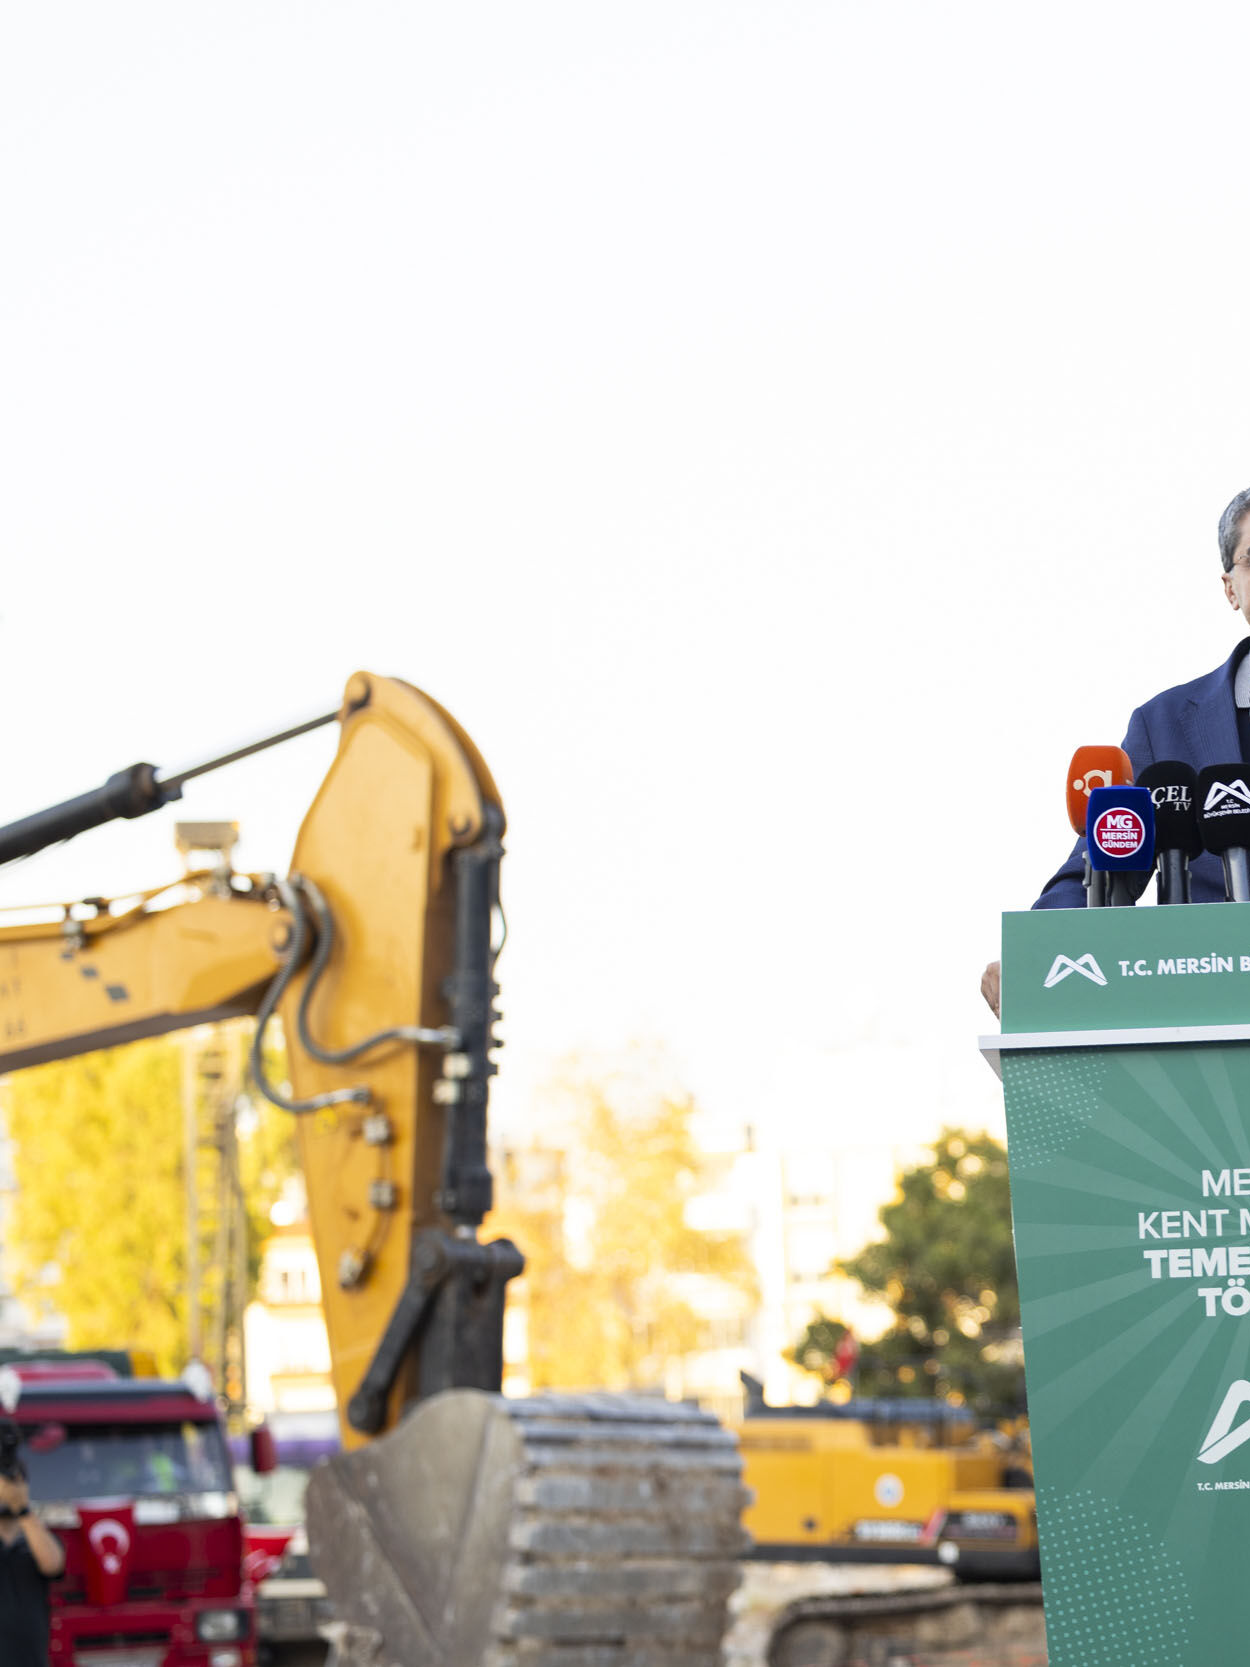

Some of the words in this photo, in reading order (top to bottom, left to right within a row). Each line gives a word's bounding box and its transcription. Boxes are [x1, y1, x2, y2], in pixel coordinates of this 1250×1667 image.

[1146, 785, 1192, 810] ÇEL
[1173, 801, 1191, 811] TV
[1106, 814, 1133, 829] MG
[1101, 830, 1138, 840] MERSİN
[1101, 840, 1138, 849] GÜNDEM
[1118, 959, 1152, 977] T.C.
[1157, 952, 1234, 975] MERSİN
[1138, 1208, 1230, 1240] KENT
[1197, 1482, 1213, 1491] T.C.
[1214, 1479, 1250, 1490] MERSİN
